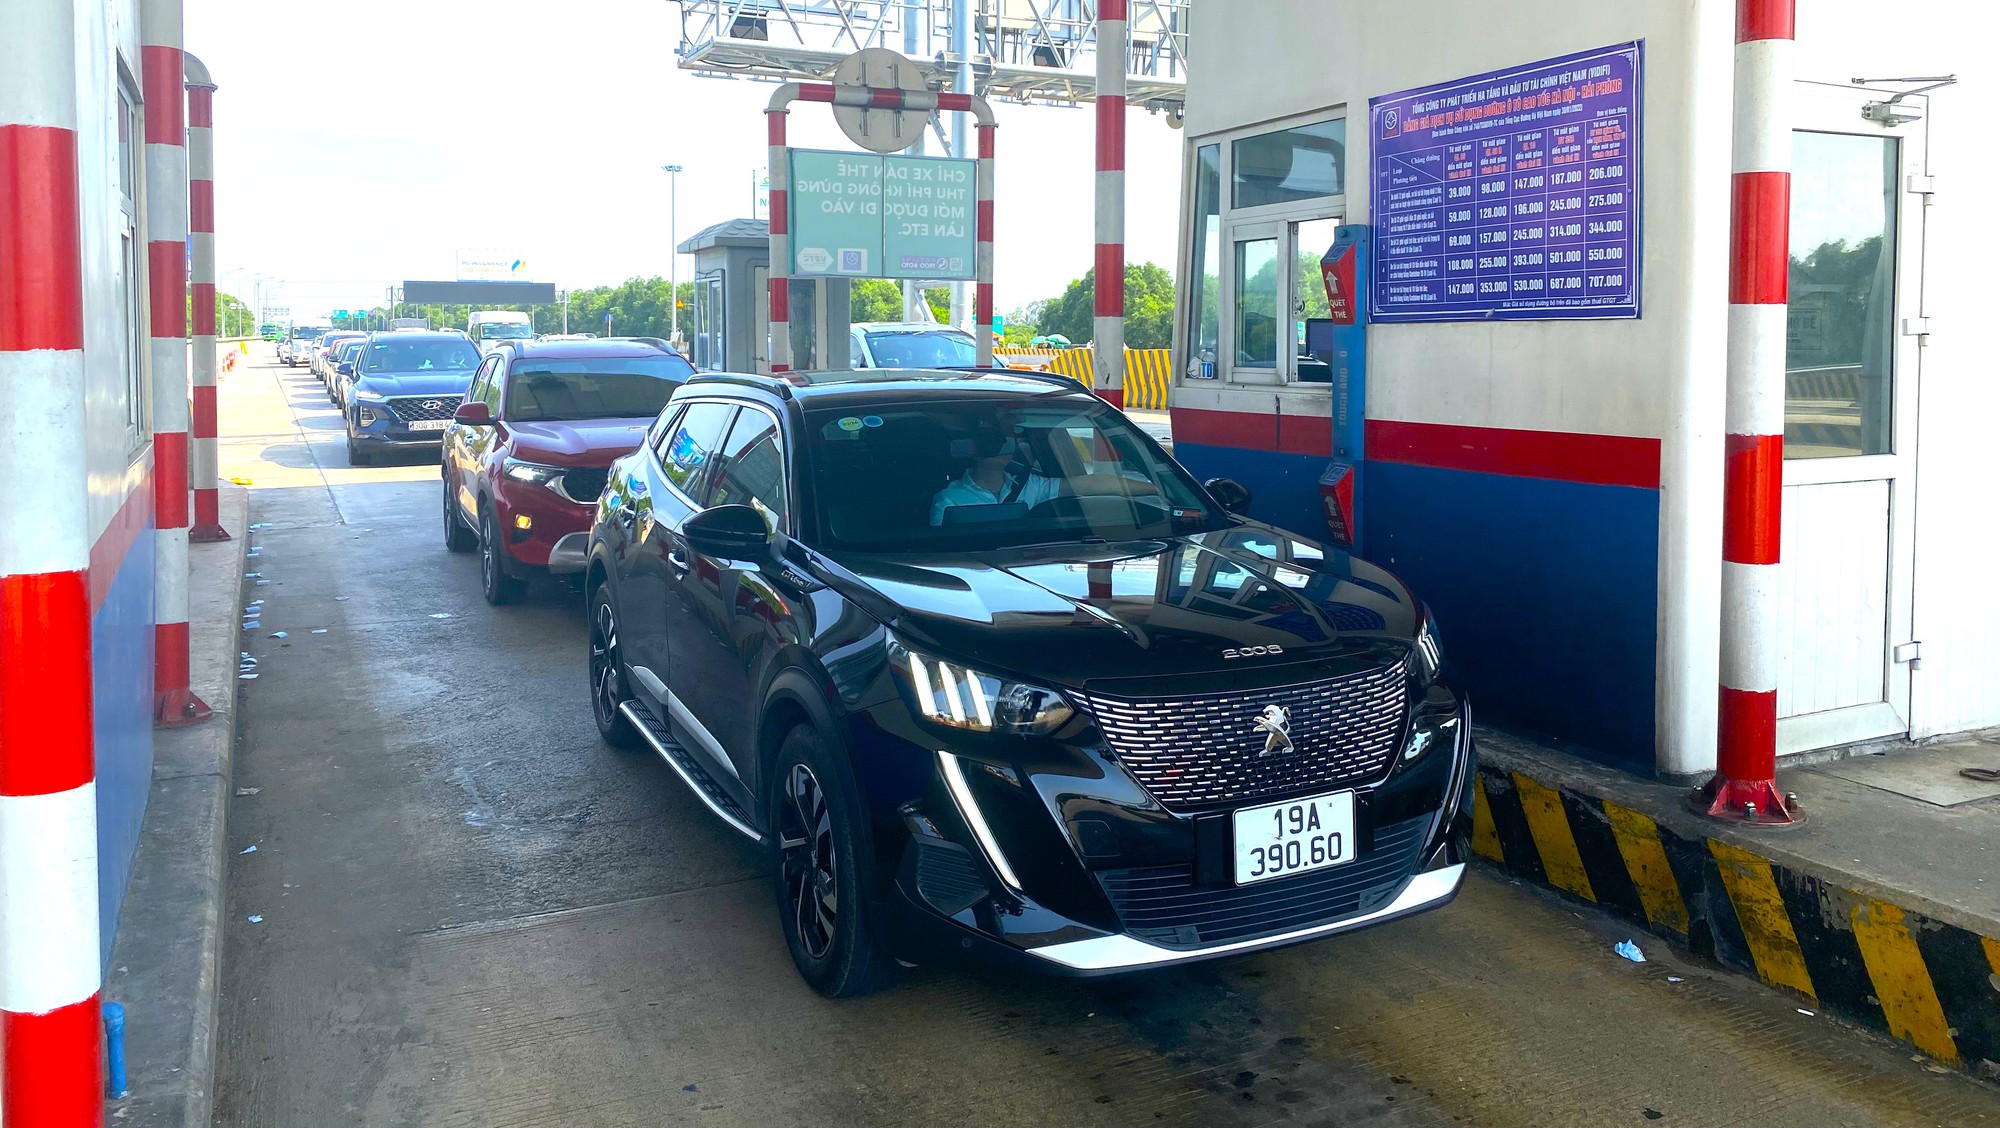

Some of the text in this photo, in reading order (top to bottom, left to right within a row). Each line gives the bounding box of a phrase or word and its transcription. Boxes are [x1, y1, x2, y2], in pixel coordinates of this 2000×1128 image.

[1426, 101, 1439, 112] CÔNG
[1440, 98, 1446, 108] TY
[1447, 94, 1460, 108] PHÁT
[1478, 90, 1486, 102] HẠ
[1502, 84, 1508, 96] VÀ
[1522, 80, 1530, 92] TƯ
[1530, 78, 1539, 90] TÀI
[1540, 75, 1558, 88] CHÍNH
[1559, 71, 1571, 86] VIỆT
[1573, 69, 1586, 82] NAM
[1588, 64, 1610, 79] (VIDIFI)
[1507, 98, 1512, 112] Ô
[1513, 96, 1521, 111] TÔ
[1522, 96, 1536, 110] CAO
[1537, 89, 1550, 108] TỐC
[1551, 88, 1562, 104] HÀ
[1562, 86, 1576, 104] NỘI
[1582, 81, 1594, 98] HẢI
[1596, 78, 1622, 96] PHÒNG
[1550, 170, 1582, 185] 187.000
[1589, 166, 1622, 180] 206.000
[1481, 180, 1505, 194] 98.000
[1514, 176, 1544, 190] 147.000
[1448, 186, 1471, 198] 39.000
[1550, 197, 1581, 212] 245.000
[1588, 192, 1622, 207] 275.000
[1449, 210, 1471, 222] 59.000
[1480, 206, 1506, 219] 128.000
[1514, 202, 1543, 216] 196.000
[1550, 224, 1581, 238] 314.000
[1588, 220, 1622, 234] 344.000
[1449, 234, 1471, 246] 69.000
[1479, 231, 1506, 244] 157.000
[1513, 228, 1542, 241] 245.000
[1513, 253, 1542, 266] 393.000
[1550, 250, 1581, 264] 501.000
[1588, 247, 1622, 261] 550.000
[1448, 259, 1474, 271] 108.000
[1479, 256, 1506, 268] 255.000
[1480, 282, 1507, 294] 353.000
[1514, 279, 1543, 291] 530.000
[1550, 277, 1581, 290] 687.000
[1588, 274, 1622, 288] 707.000
[1448, 283, 1474, 294] 147.000
[1340, 368, 1348, 390] AND
[1339, 393, 1348, 426] TOUCH
[1222, 644, 1283, 658] 2008
[1274, 802, 1321, 837] 19A
[1250, 832, 1342, 876] 390.60
